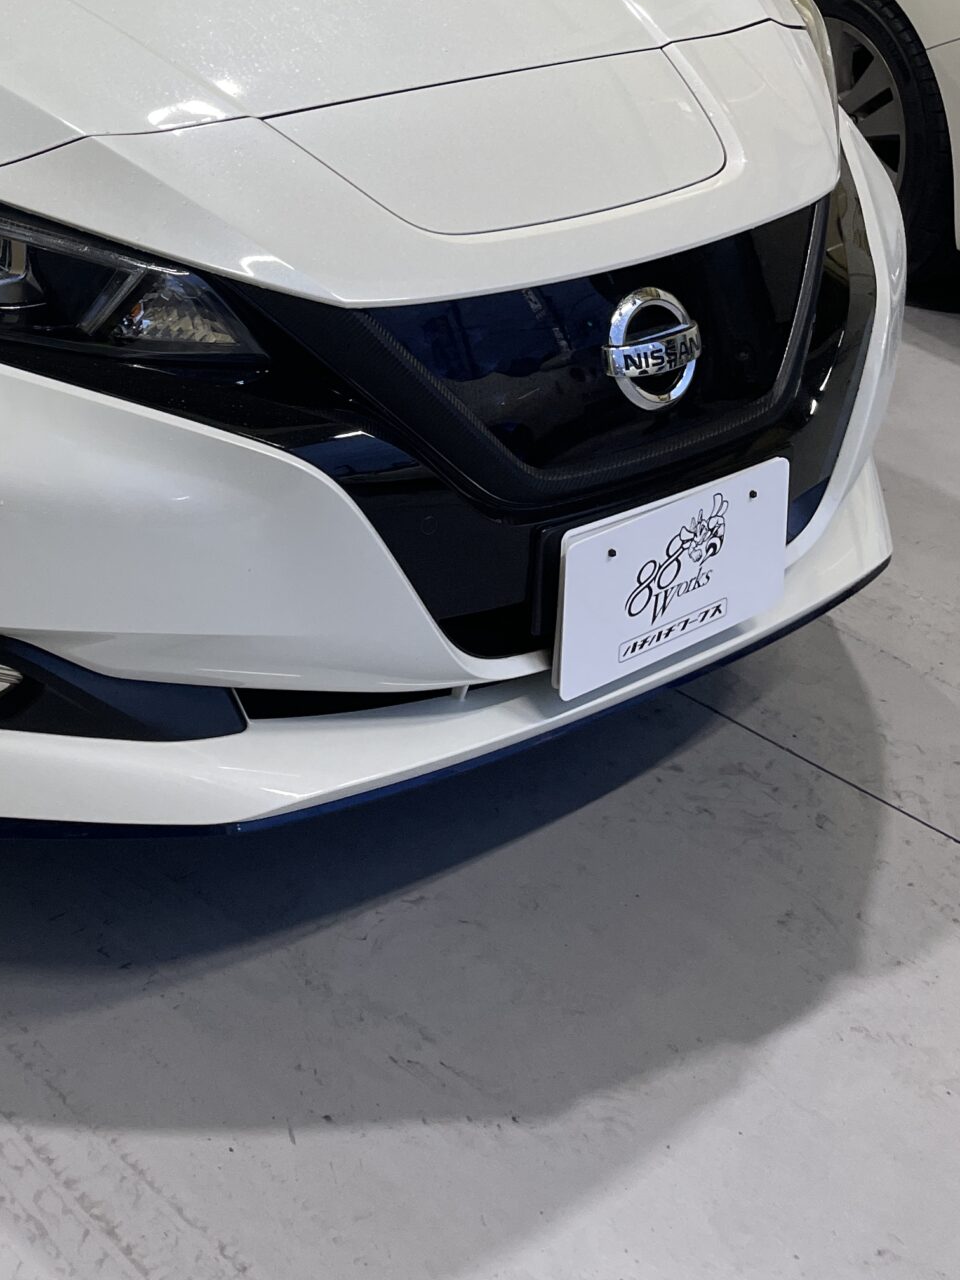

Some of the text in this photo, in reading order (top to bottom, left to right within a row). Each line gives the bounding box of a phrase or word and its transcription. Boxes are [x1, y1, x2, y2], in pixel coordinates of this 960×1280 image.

[623, 334, 699, 371] NISSAN
[651, 567, 713, 625] Works
[623, 604, 722, 657] ハチハチワークス
